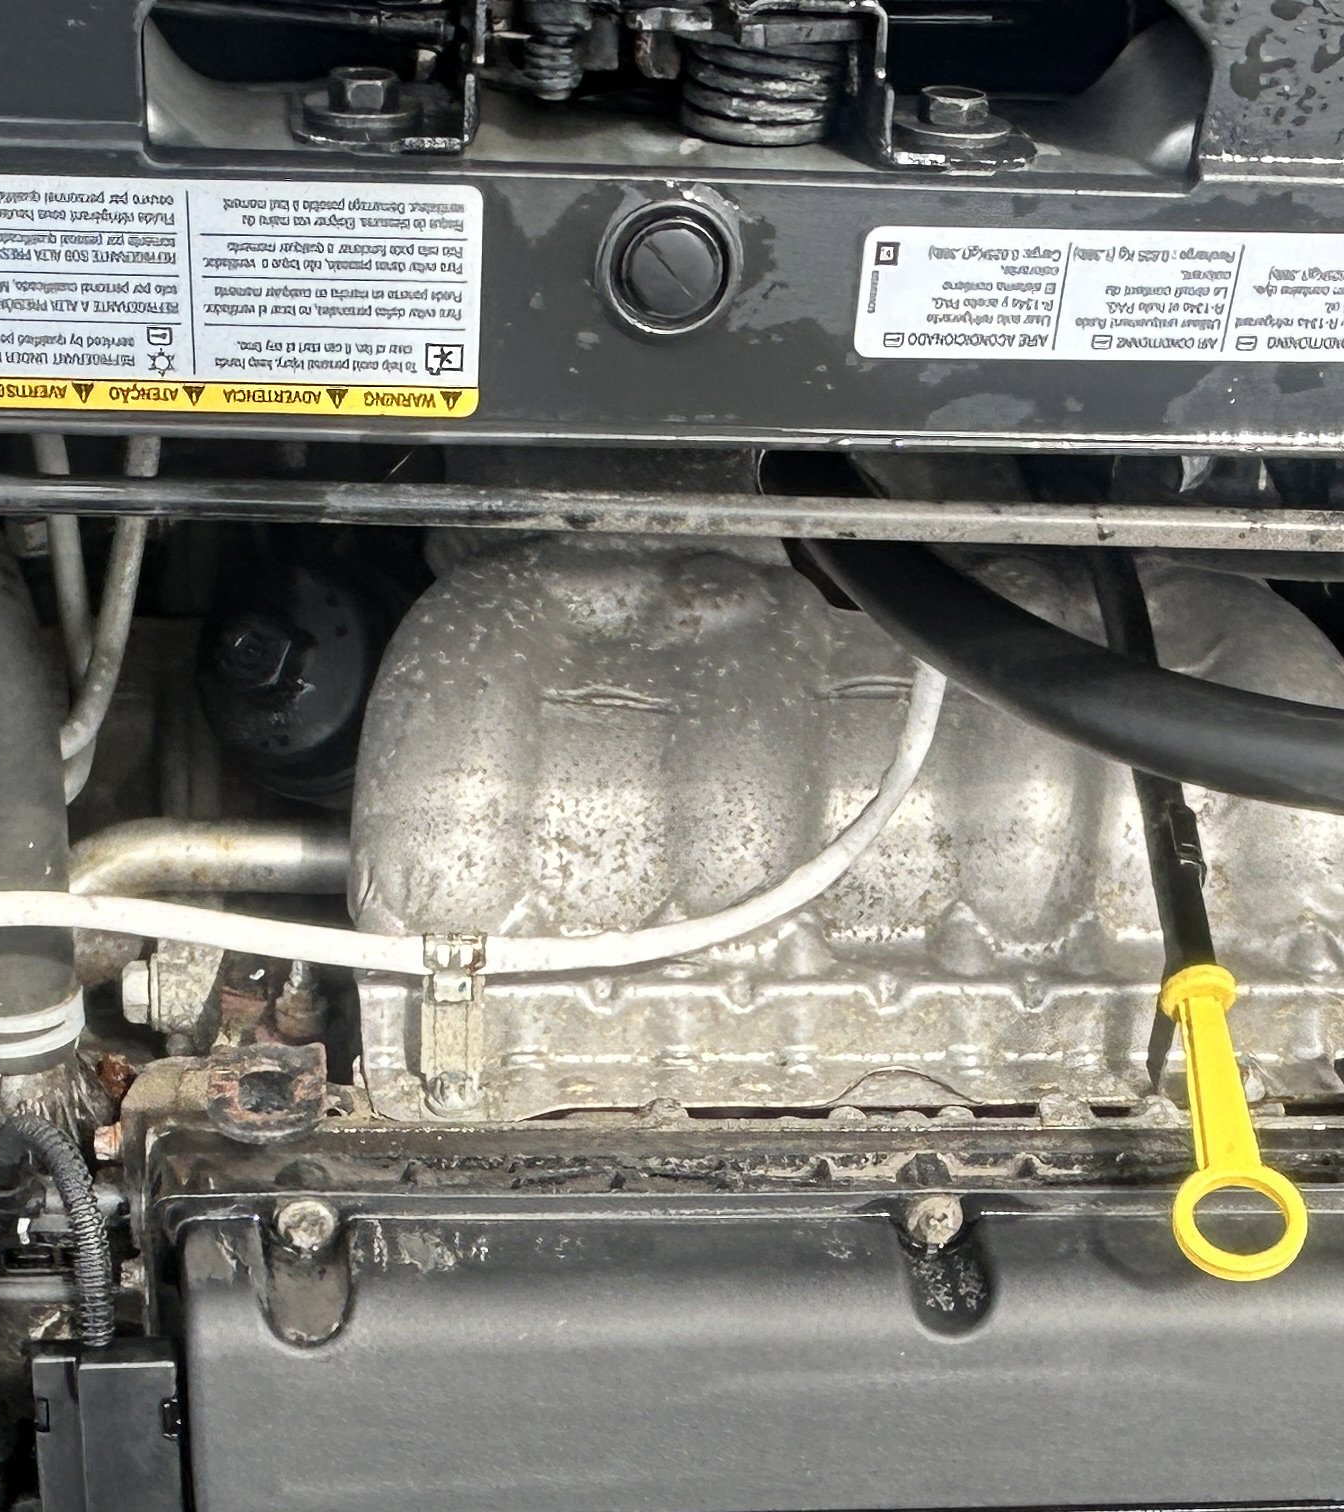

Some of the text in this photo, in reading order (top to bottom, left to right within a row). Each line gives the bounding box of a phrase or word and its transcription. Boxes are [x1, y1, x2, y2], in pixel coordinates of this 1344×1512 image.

[109, 384, 179, 403] ATENÇÃO
[223, 388, 322, 404] ADVERTENCIA
[364, 392, 436, 408] WARNING
